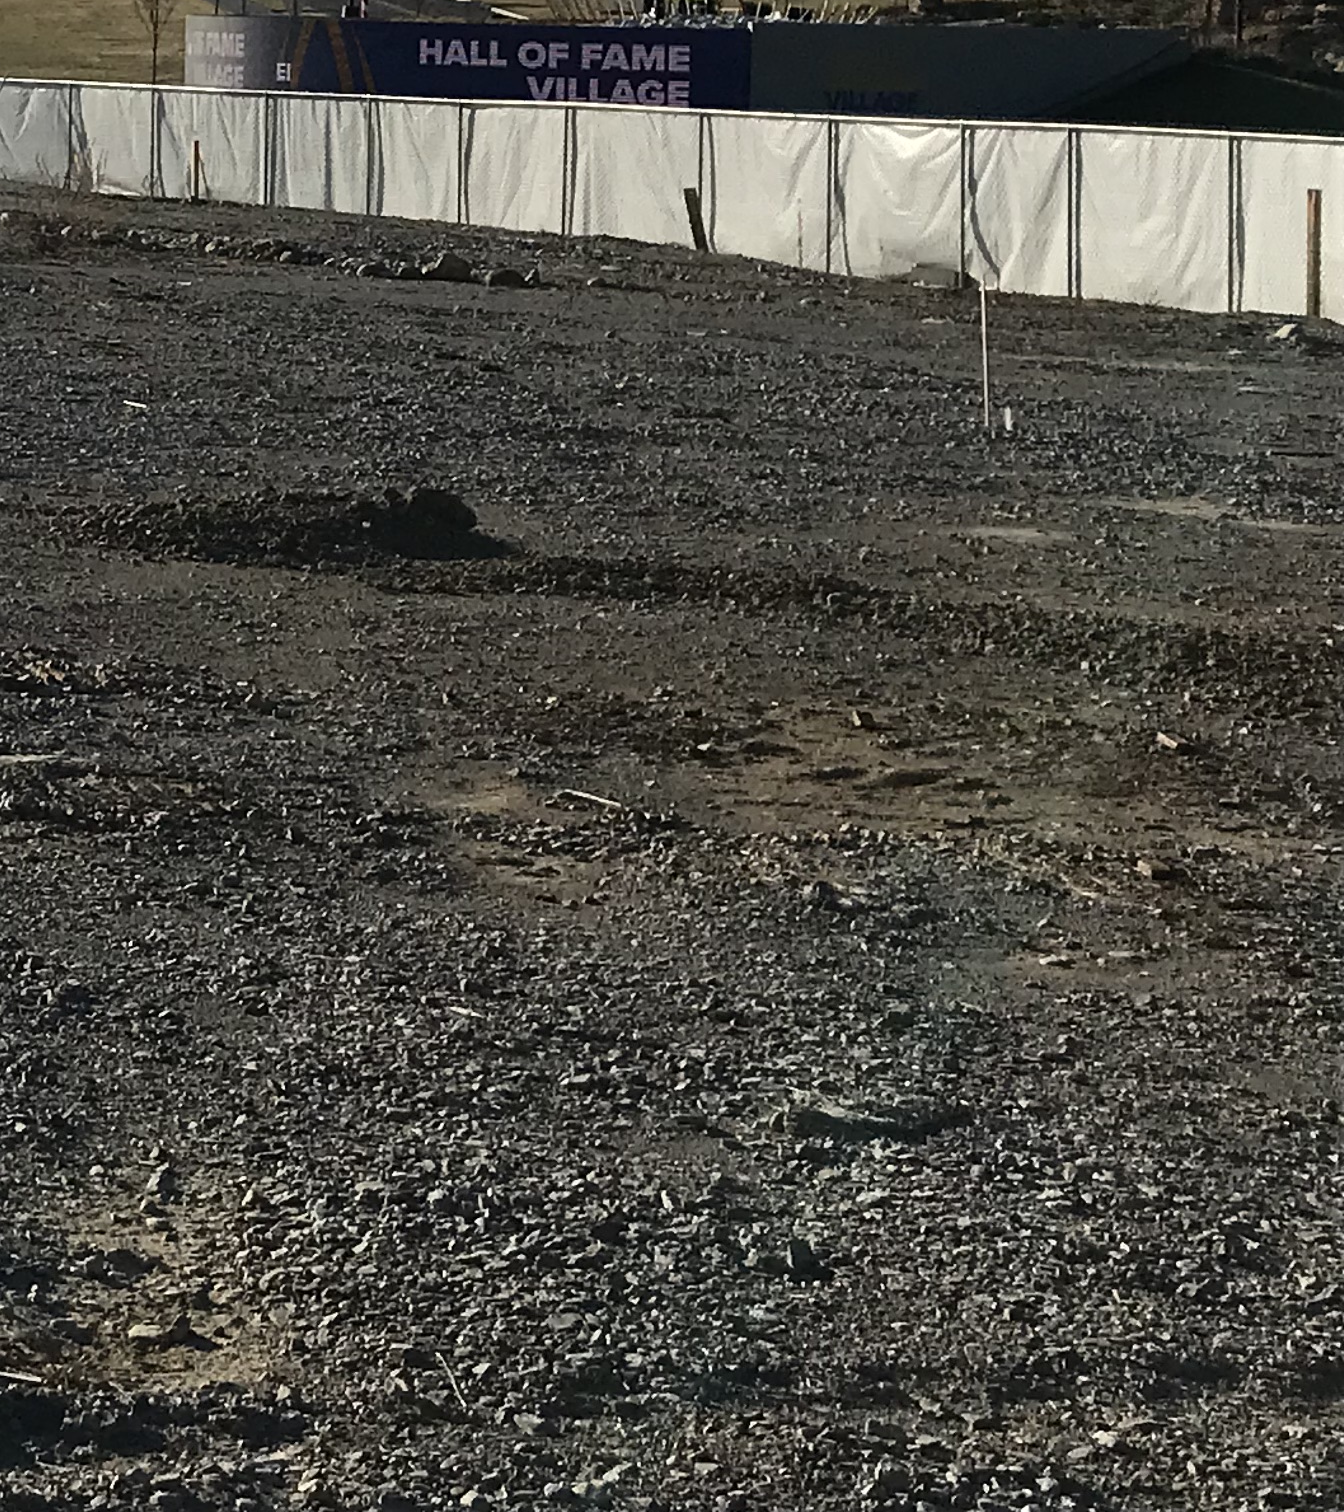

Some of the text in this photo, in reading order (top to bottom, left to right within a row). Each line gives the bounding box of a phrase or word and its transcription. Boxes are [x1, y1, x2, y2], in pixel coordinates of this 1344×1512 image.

[419, 38, 690, 71] HALL OF FAME
[526, 75, 690, 108] VILLAGE
